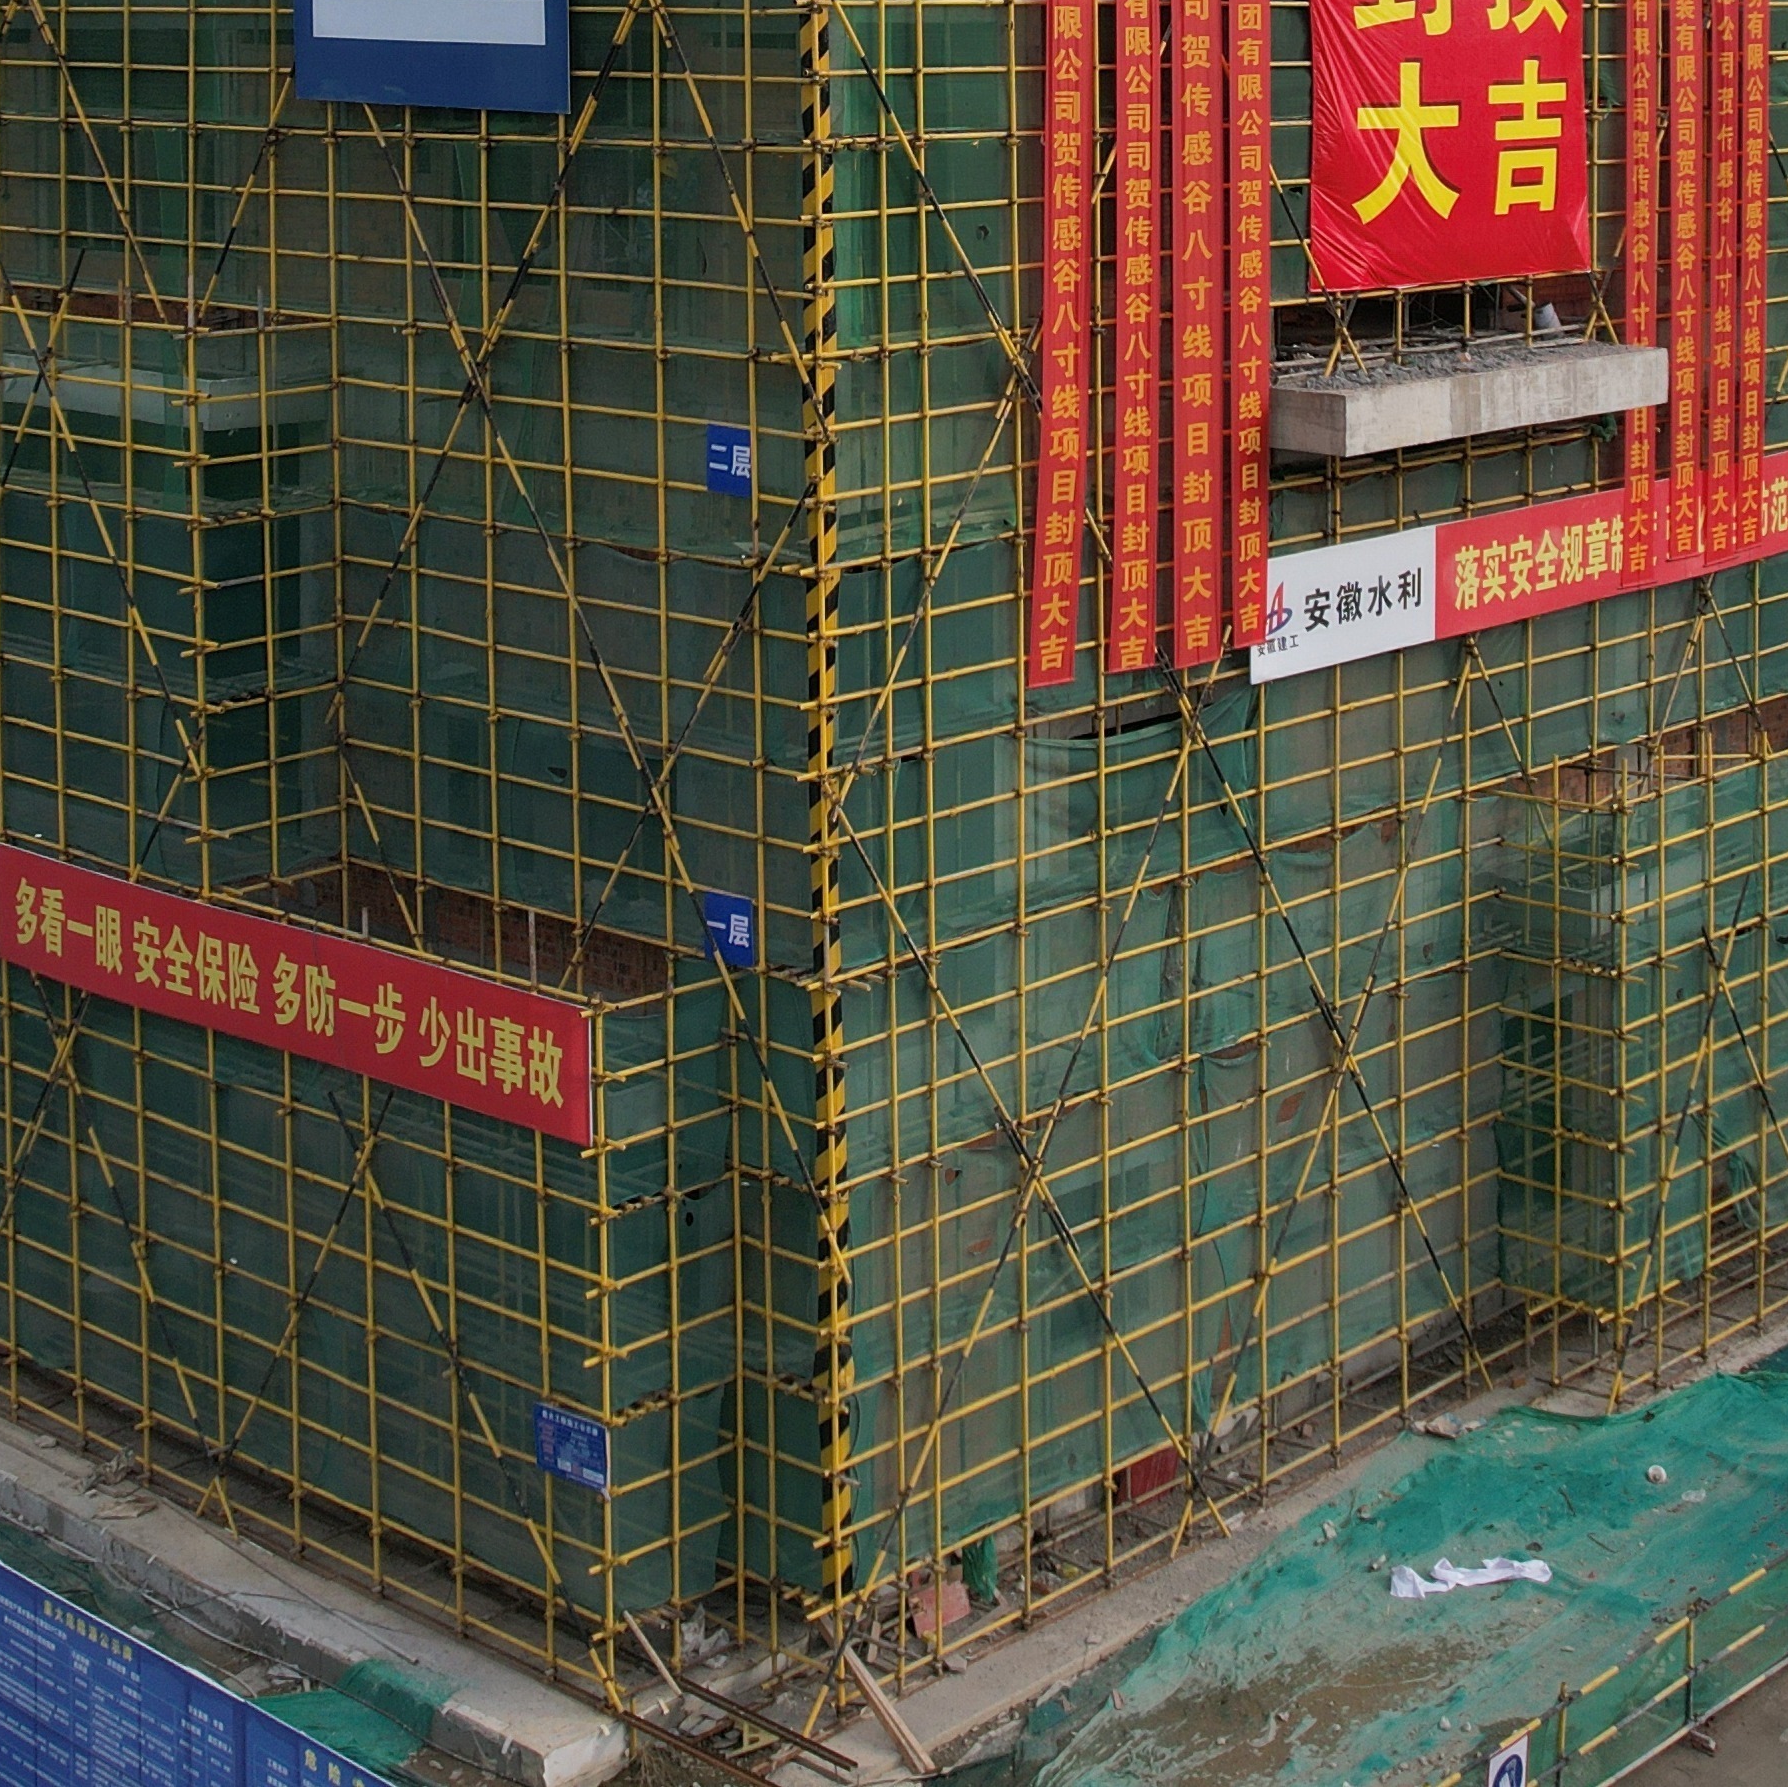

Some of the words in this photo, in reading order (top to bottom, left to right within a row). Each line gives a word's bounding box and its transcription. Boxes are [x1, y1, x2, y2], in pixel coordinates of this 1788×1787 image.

[1352, 58, 1567, 225] 大吉
[1304, 567, 1422, 632] 安徽水利
[15, 878, 123, 975] 多看一眼
[133, 915, 260, 1015] 安全保险
[273, 953, 407, 1054] 多防一步
[418, 996, 564, 1108] 少出事故
